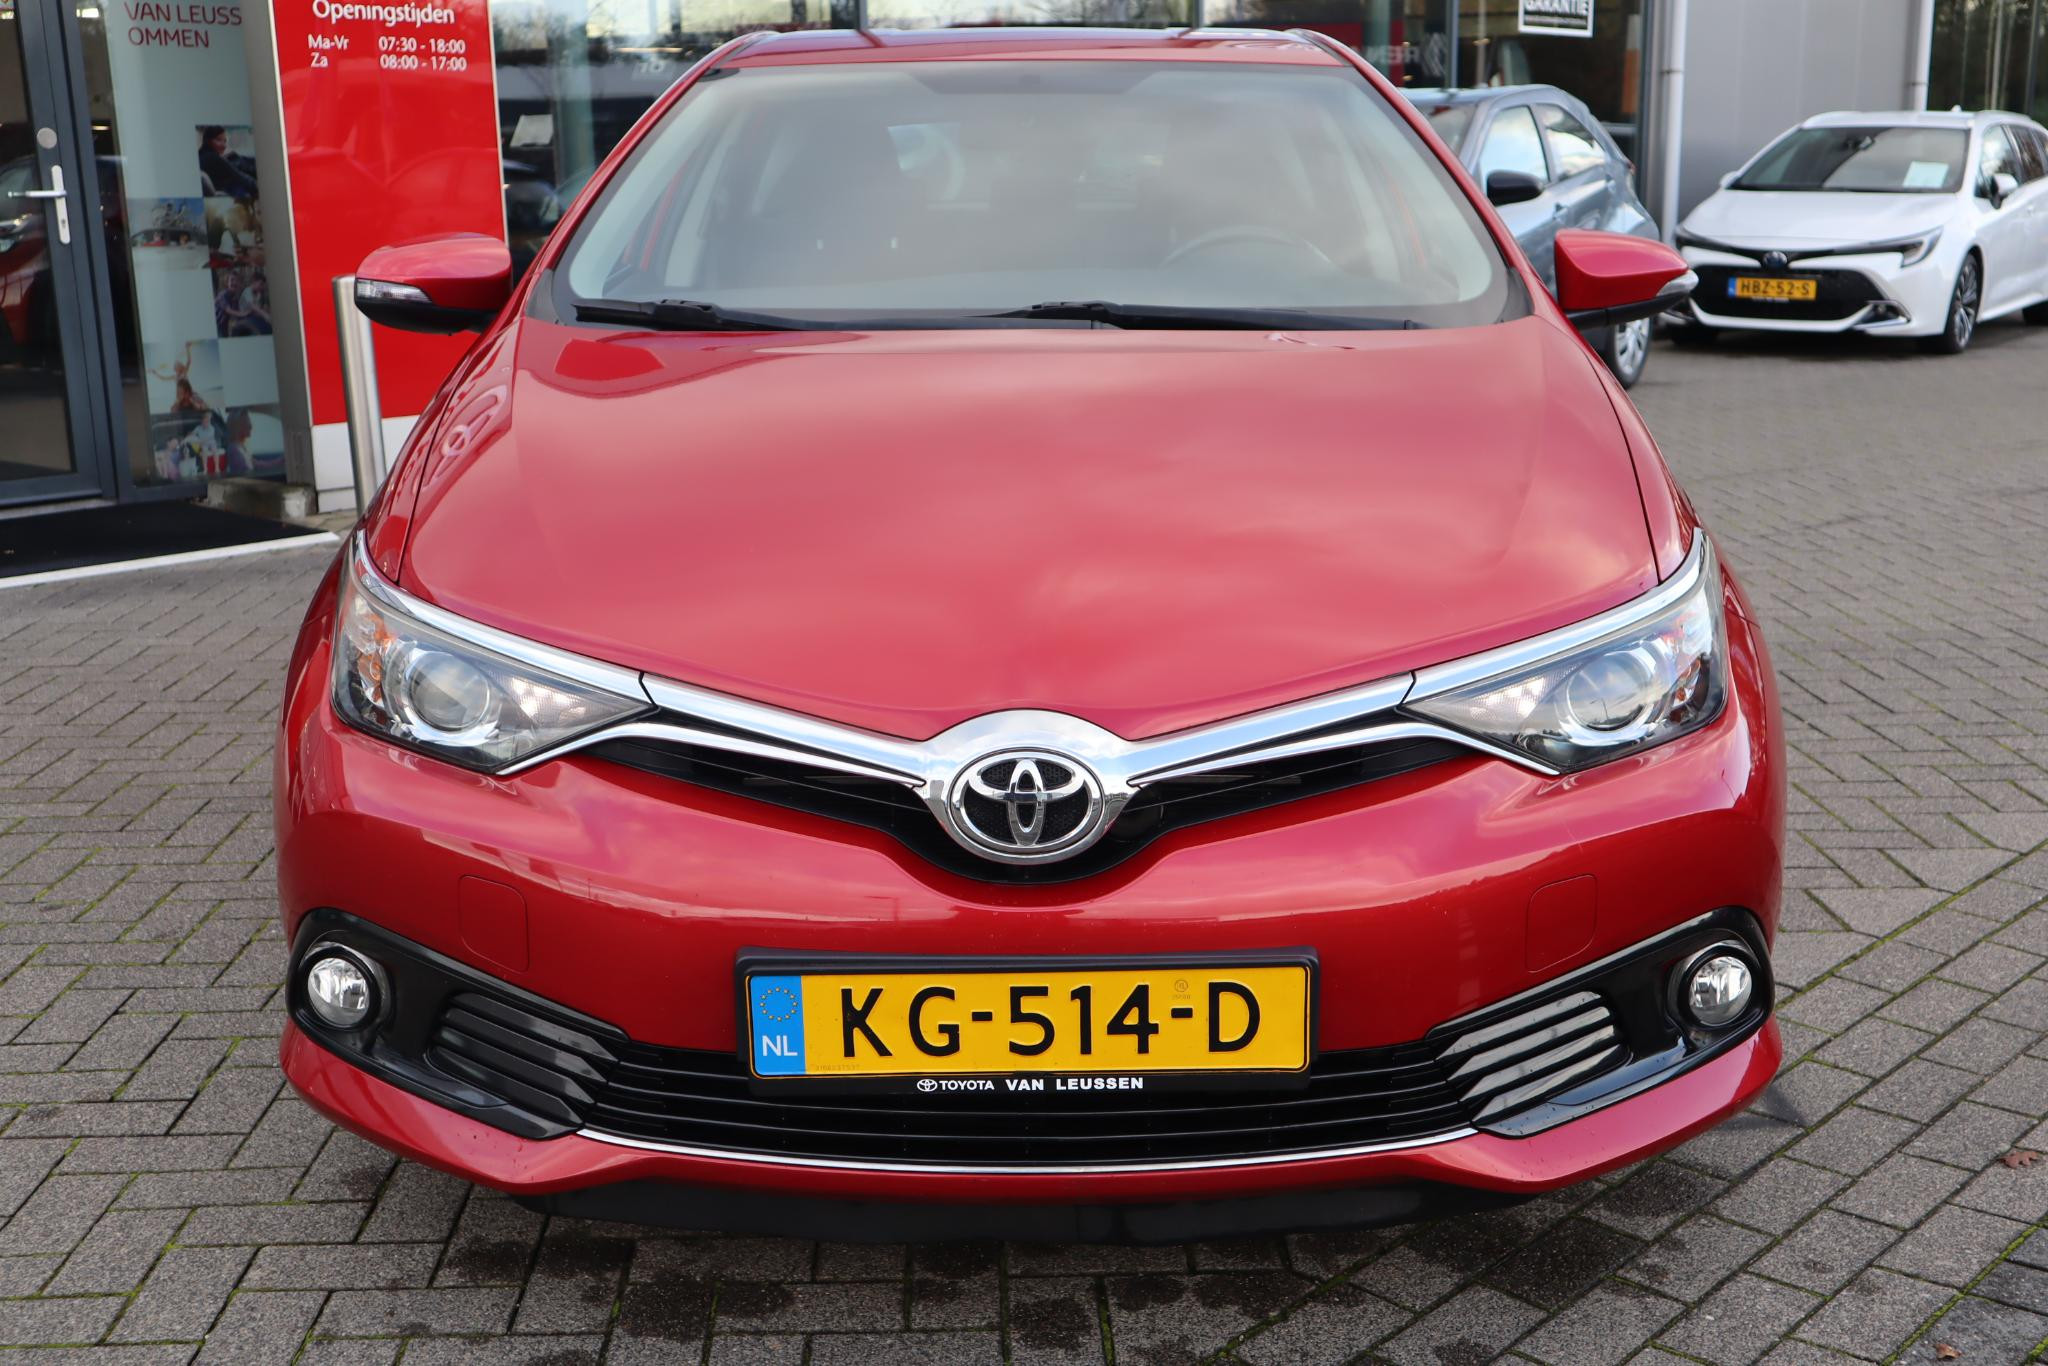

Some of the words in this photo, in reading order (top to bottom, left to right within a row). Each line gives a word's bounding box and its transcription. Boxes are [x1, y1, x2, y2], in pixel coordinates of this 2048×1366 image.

[124, 1, 171, 22] VAN
[176, 4, 242, 26] LEUSS
[312, 0, 456, 28] Openingstijden
[128, 26, 209, 48] OMMEN
[308, 34, 350, 50] Ma-Vr
[378, 36, 417, 52] 07:30
[429, 38, 466, 54] 18:00
[311, 52, 328, 68] Za
[380, 54, 418, 70] 08:00
[431, 56, 467, 71] 17:00
[840, 981, 1261, 1058] KG-514-D
[762, 1035, 798, 1057] NL
[939, 1079, 995, 1091] TOYOTA
[1005, 1078, 1044, 1091] VAN
[1056, 1077, 1144, 1091] LEUSSEN
